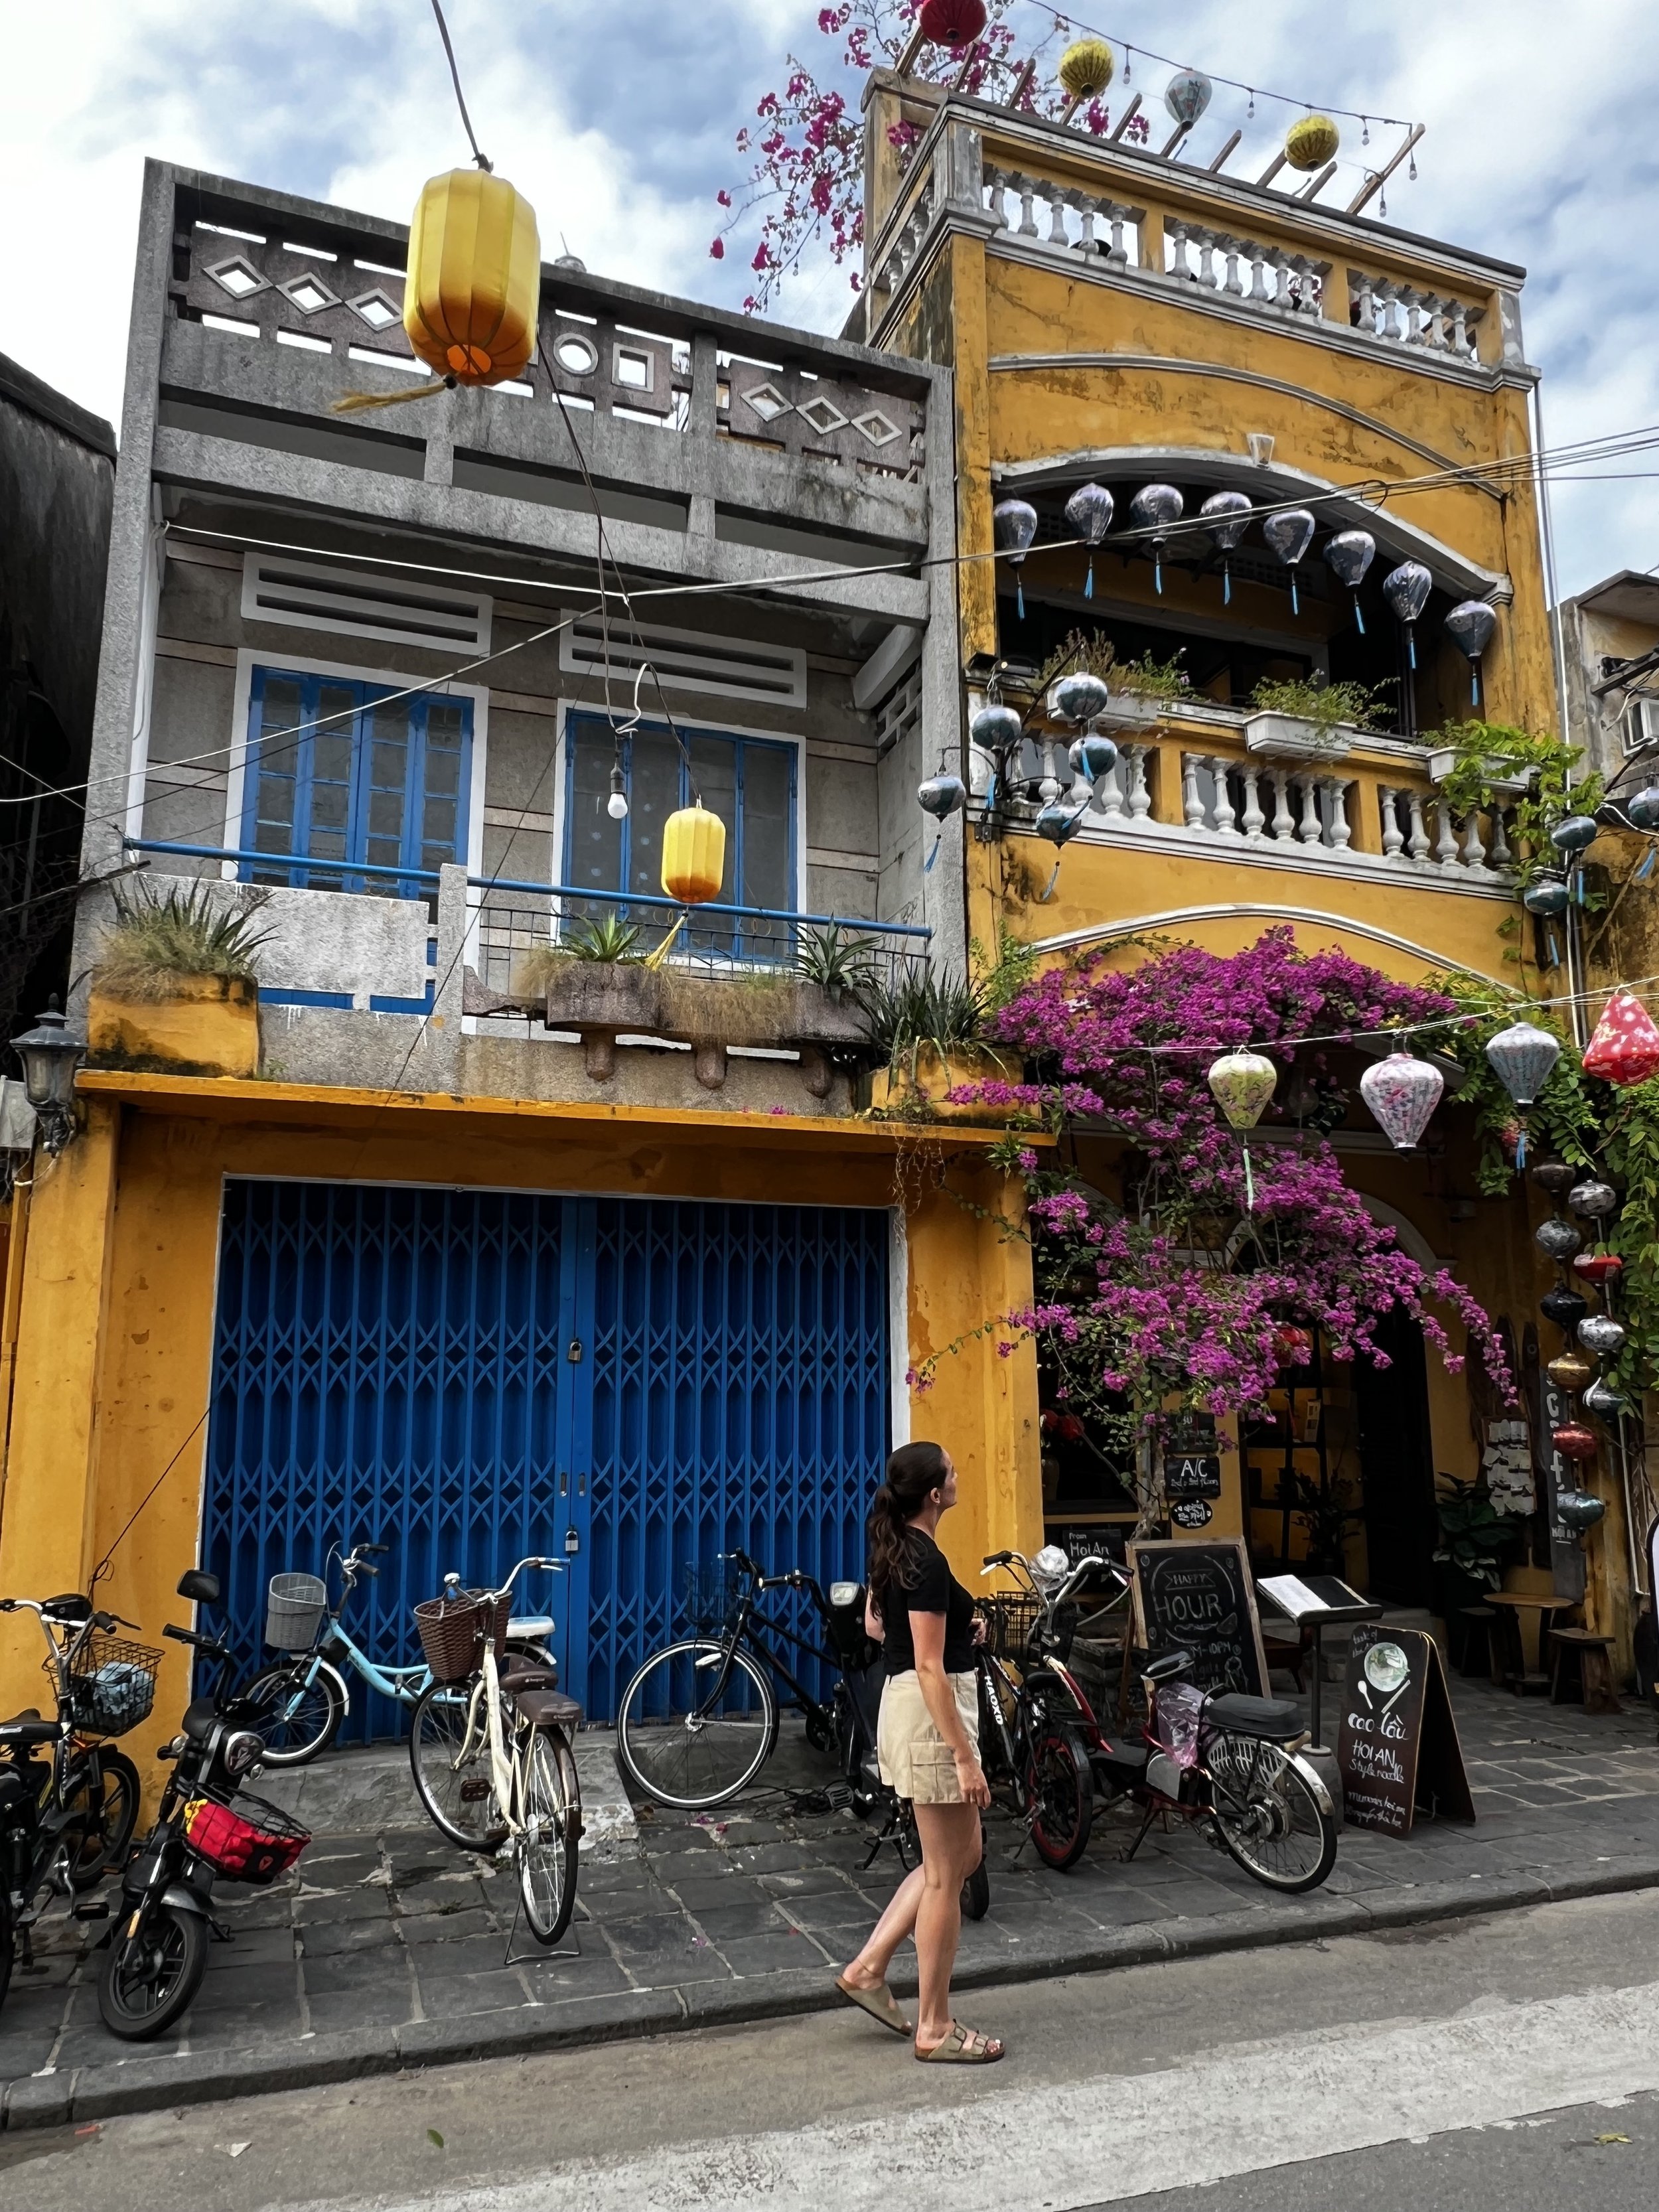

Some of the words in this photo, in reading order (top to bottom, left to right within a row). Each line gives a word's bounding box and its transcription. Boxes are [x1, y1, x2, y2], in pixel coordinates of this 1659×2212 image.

[1181, 1458, 1208, 1477] A/C
[1153, 1593, 1222, 1623] HOUR
[1352, 1739, 1374, 1761] HOI
[1374, 1748, 1396, 1769] AN
